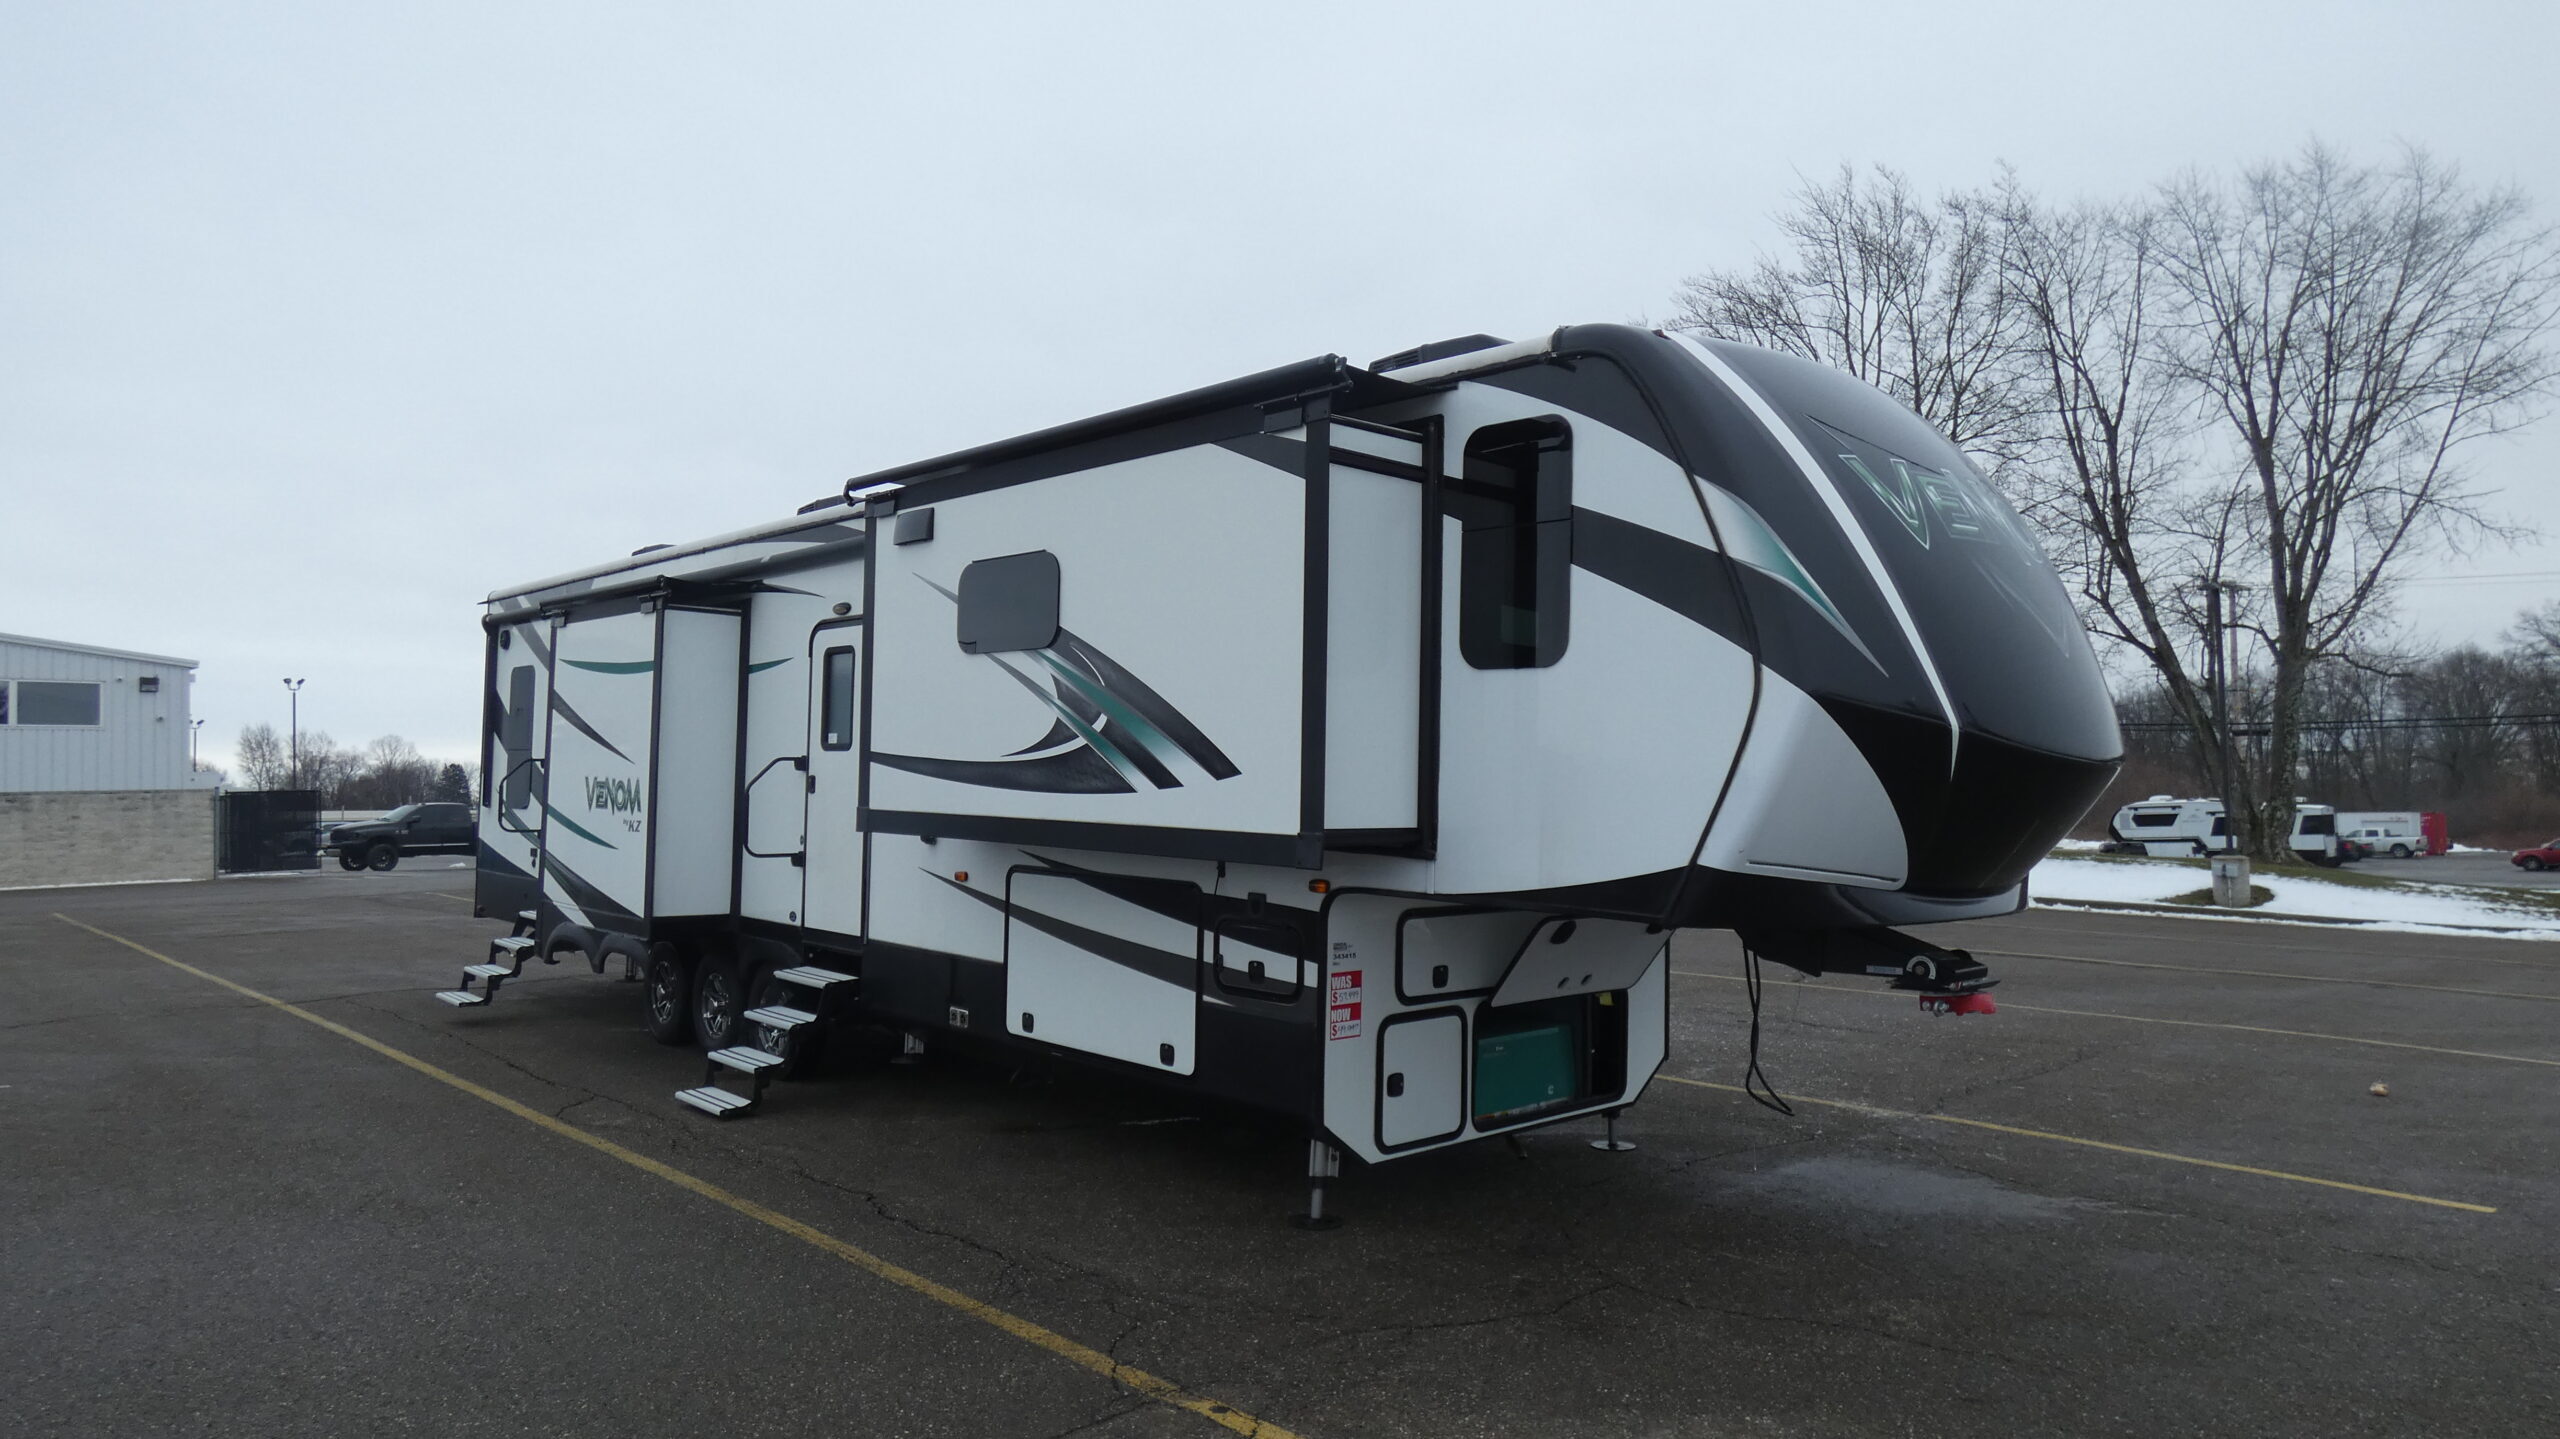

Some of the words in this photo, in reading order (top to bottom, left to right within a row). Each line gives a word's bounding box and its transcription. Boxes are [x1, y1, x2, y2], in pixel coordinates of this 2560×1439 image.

[585, 776, 641, 815] VENOM
[628, 820, 641, 832] KZ
[1331, 975, 1352, 989] WAS
[1331, 1007, 1351, 1023] NOW
